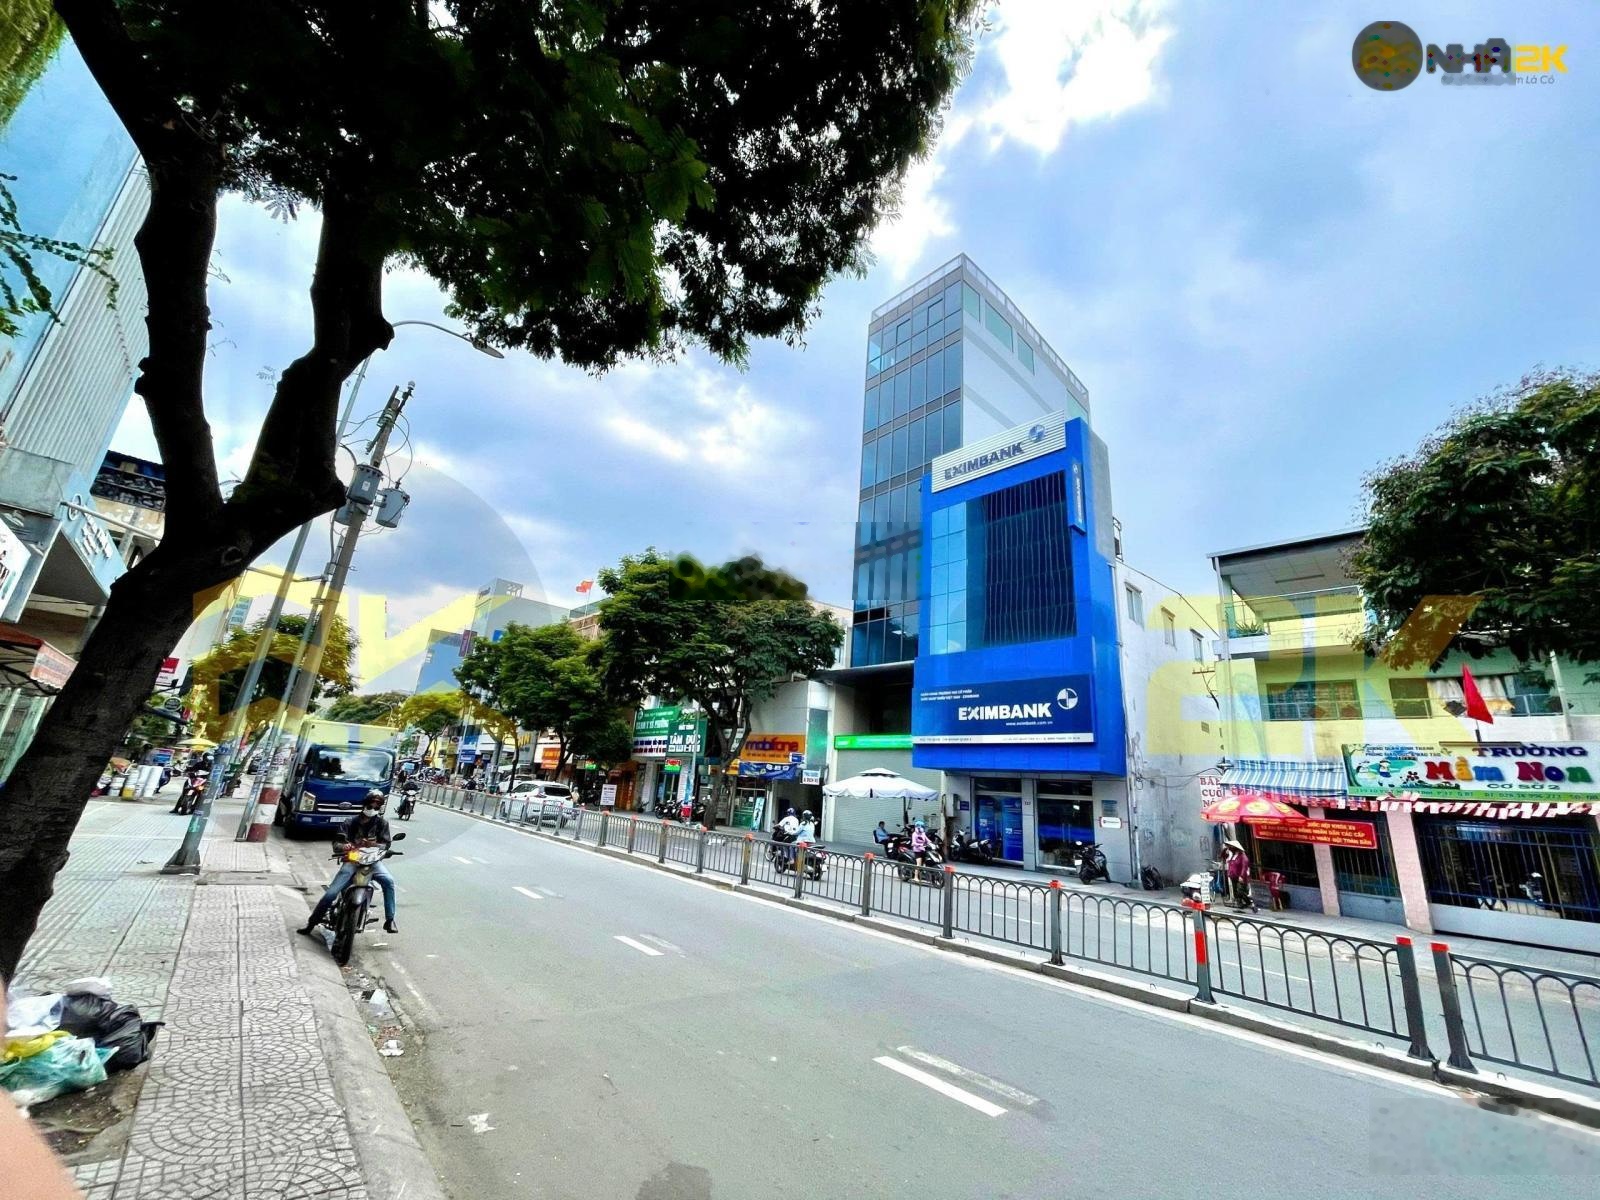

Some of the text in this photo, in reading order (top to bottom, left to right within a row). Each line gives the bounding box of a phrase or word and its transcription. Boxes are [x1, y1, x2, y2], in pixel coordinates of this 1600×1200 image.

[944, 442, 1026, 481] EXIMBANK
[958, 703, 1052, 721] EXIMBANK
[745, 737, 799, 752] mobifone
[1471, 743, 1589, 758] TRƯỜNG
[1424, 755, 1595, 783] Mầm Non
